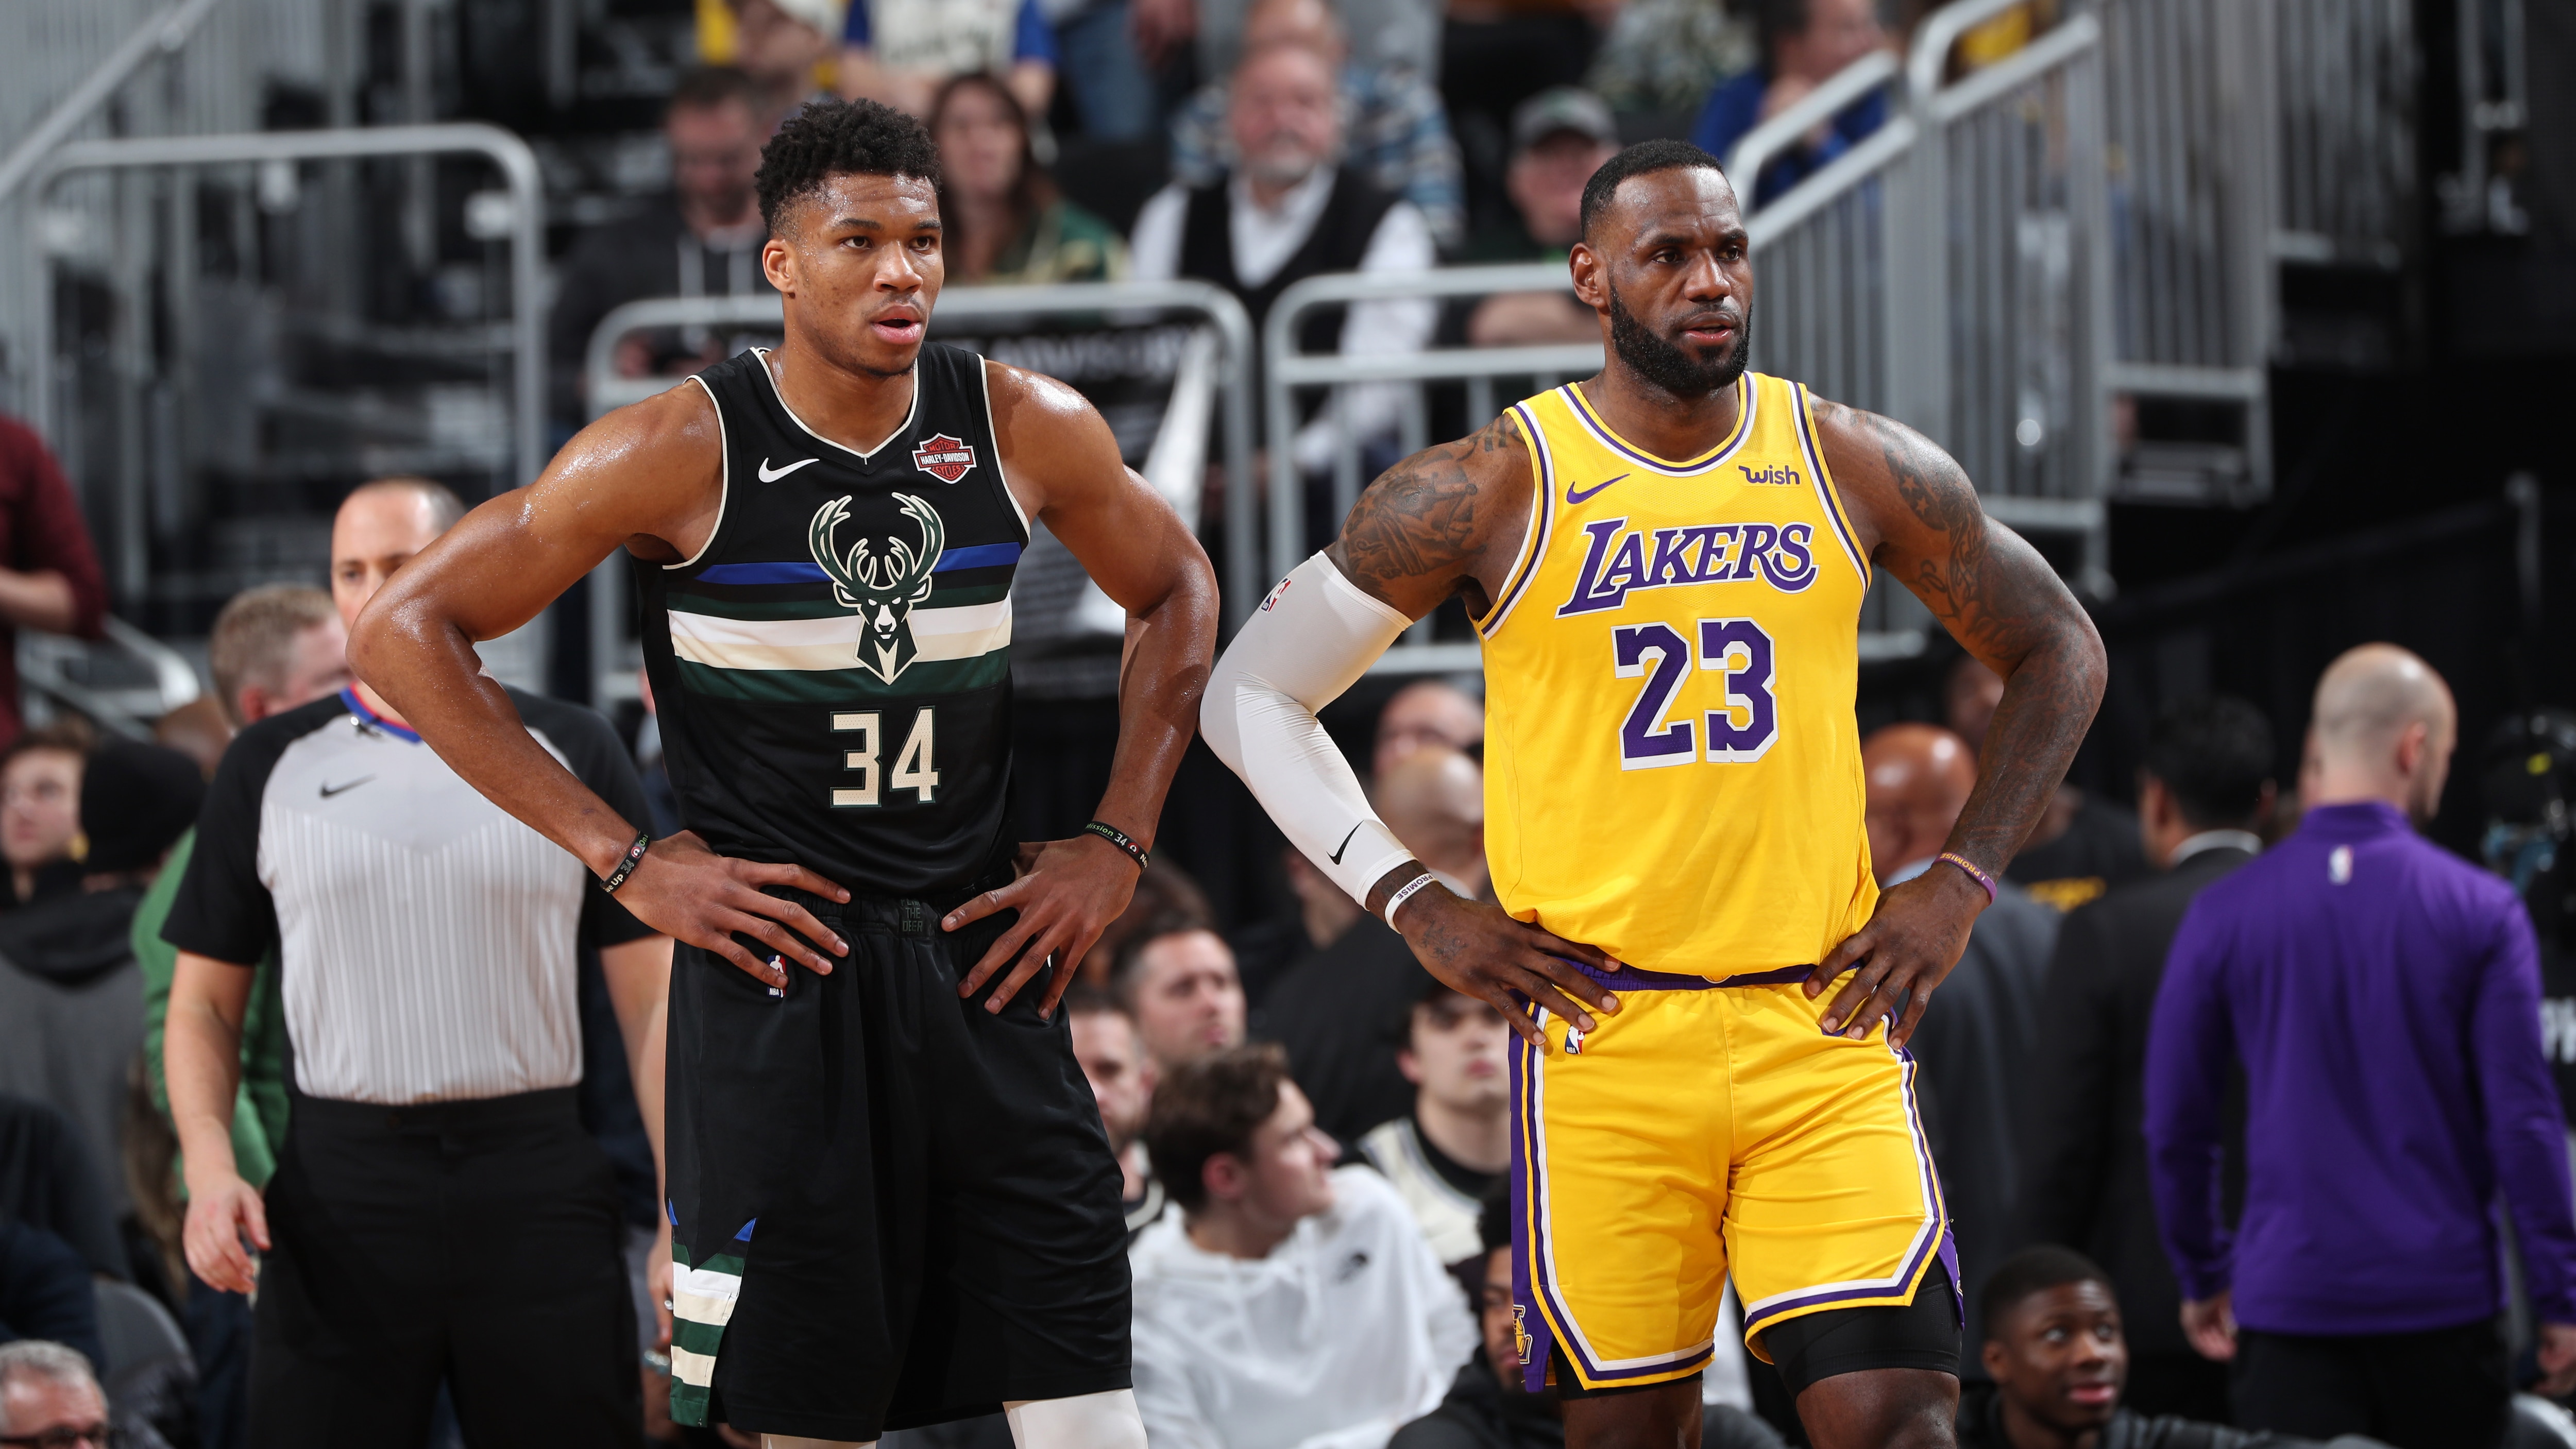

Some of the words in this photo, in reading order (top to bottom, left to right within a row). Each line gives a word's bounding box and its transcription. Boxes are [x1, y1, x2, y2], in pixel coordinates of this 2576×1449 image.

[929, 441, 956, 451] MOTOR
[920, 452, 970, 465] HARLEY-DAVIDSON
[936, 465, 960, 477] CYCLES
[1738, 465, 1800, 485] wish
[1554, 516, 1820, 619] LAKERS
[1611, 617, 1778, 771] 23
[830, 706, 941, 808] 34
[1114, 833, 1127, 846] 34
[611, 874, 624, 885] Up
[620, 859, 634, 874] 34
[1939, 853, 1981, 877] PROMISE
[1396, 874, 1433, 900] PROMISE
[905, 907, 921, 919] THE
[902, 920, 923, 932] DEER
[769, 987, 779, 996] NBA
